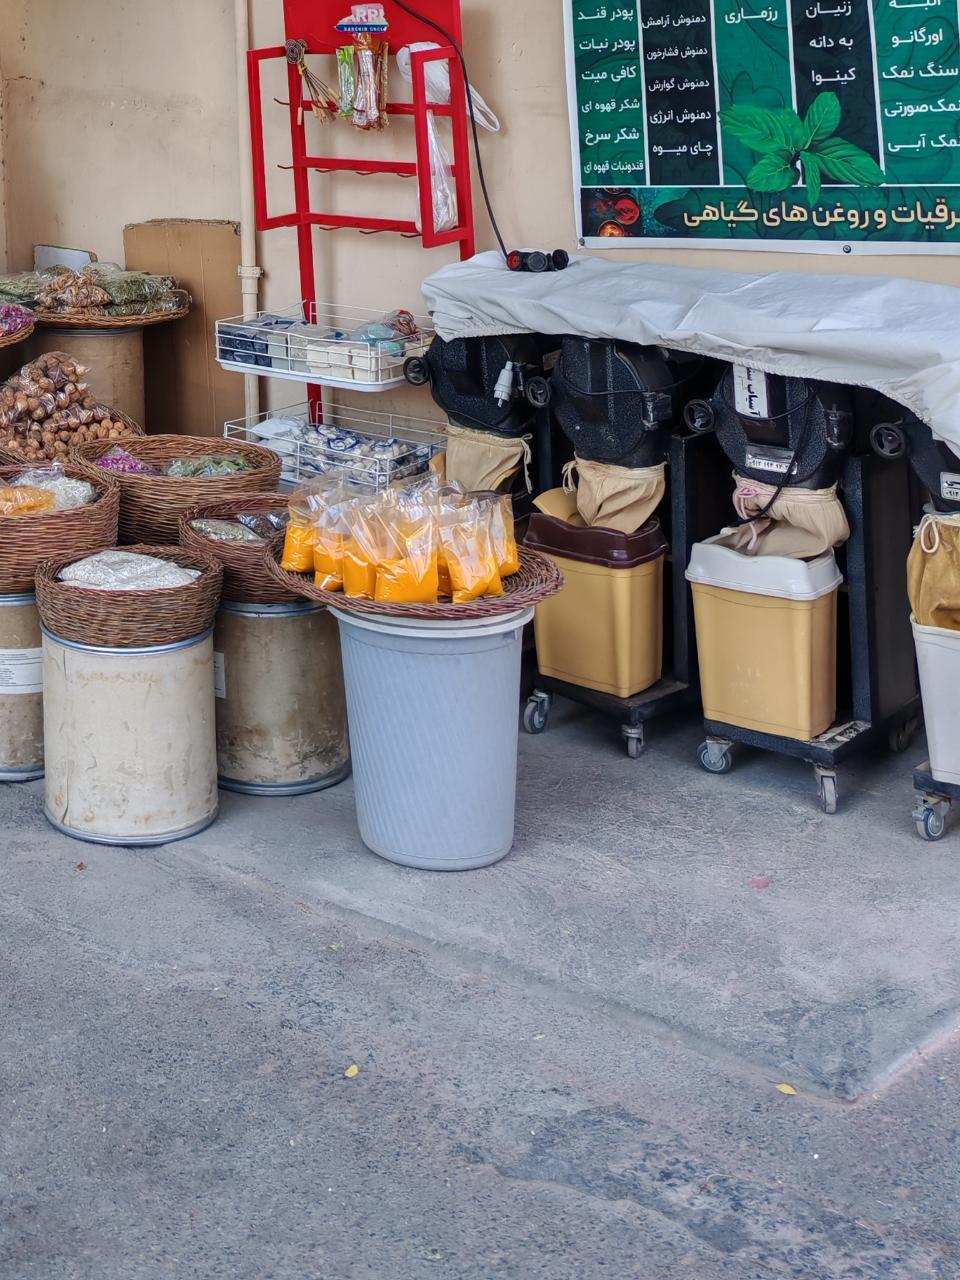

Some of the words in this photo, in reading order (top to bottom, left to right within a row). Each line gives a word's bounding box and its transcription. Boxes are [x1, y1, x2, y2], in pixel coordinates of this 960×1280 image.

[578, 6, 607, 20] قند
[610, 9, 633, 21] پودر
[725, 7, 778, 24] رزماری
[806, 1, 851, 18] زنیان
[641, 15, 670, 29] آرامش
[672, 14, 706, 27] دمنوش
[809, 35, 834, 48] دانه
[839, 37, 853, 50] به
[892, 27, 943, 48] اورگانو
[579, 38, 608, 52] نبات
[612, 39, 635, 52] پودر
[611, 66, 636, 82] کافی
[811, 67, 856, 85] کینوا
[882, 65, 914, 79] نمک
[919, 62, 959, 77] سنگ
[581, 71, 608, 83] میت
[677, 78, 710, 90] دمنوش
[648, 78, 675, 92] گوارش
[581, 101, 592, 113] ای
[595, 99, 616, 112] قهوه
[619, 98, 640, 112] شکر
[649, 110, 673, 124] انرژی
[676, 109, 711, 123] دمنوش
[585, 129, 611, 146] سرخ
[614, 128, 639, 143] شکر
[652, 145, 687, 156] میوه
[690, 141, 713, 156] چای
[684, 200, 758, 227] گیاهی
[763, 201, 808, 226] های
[812, 203, 869, 229] روغن
[874, 210, 886, 229] و
